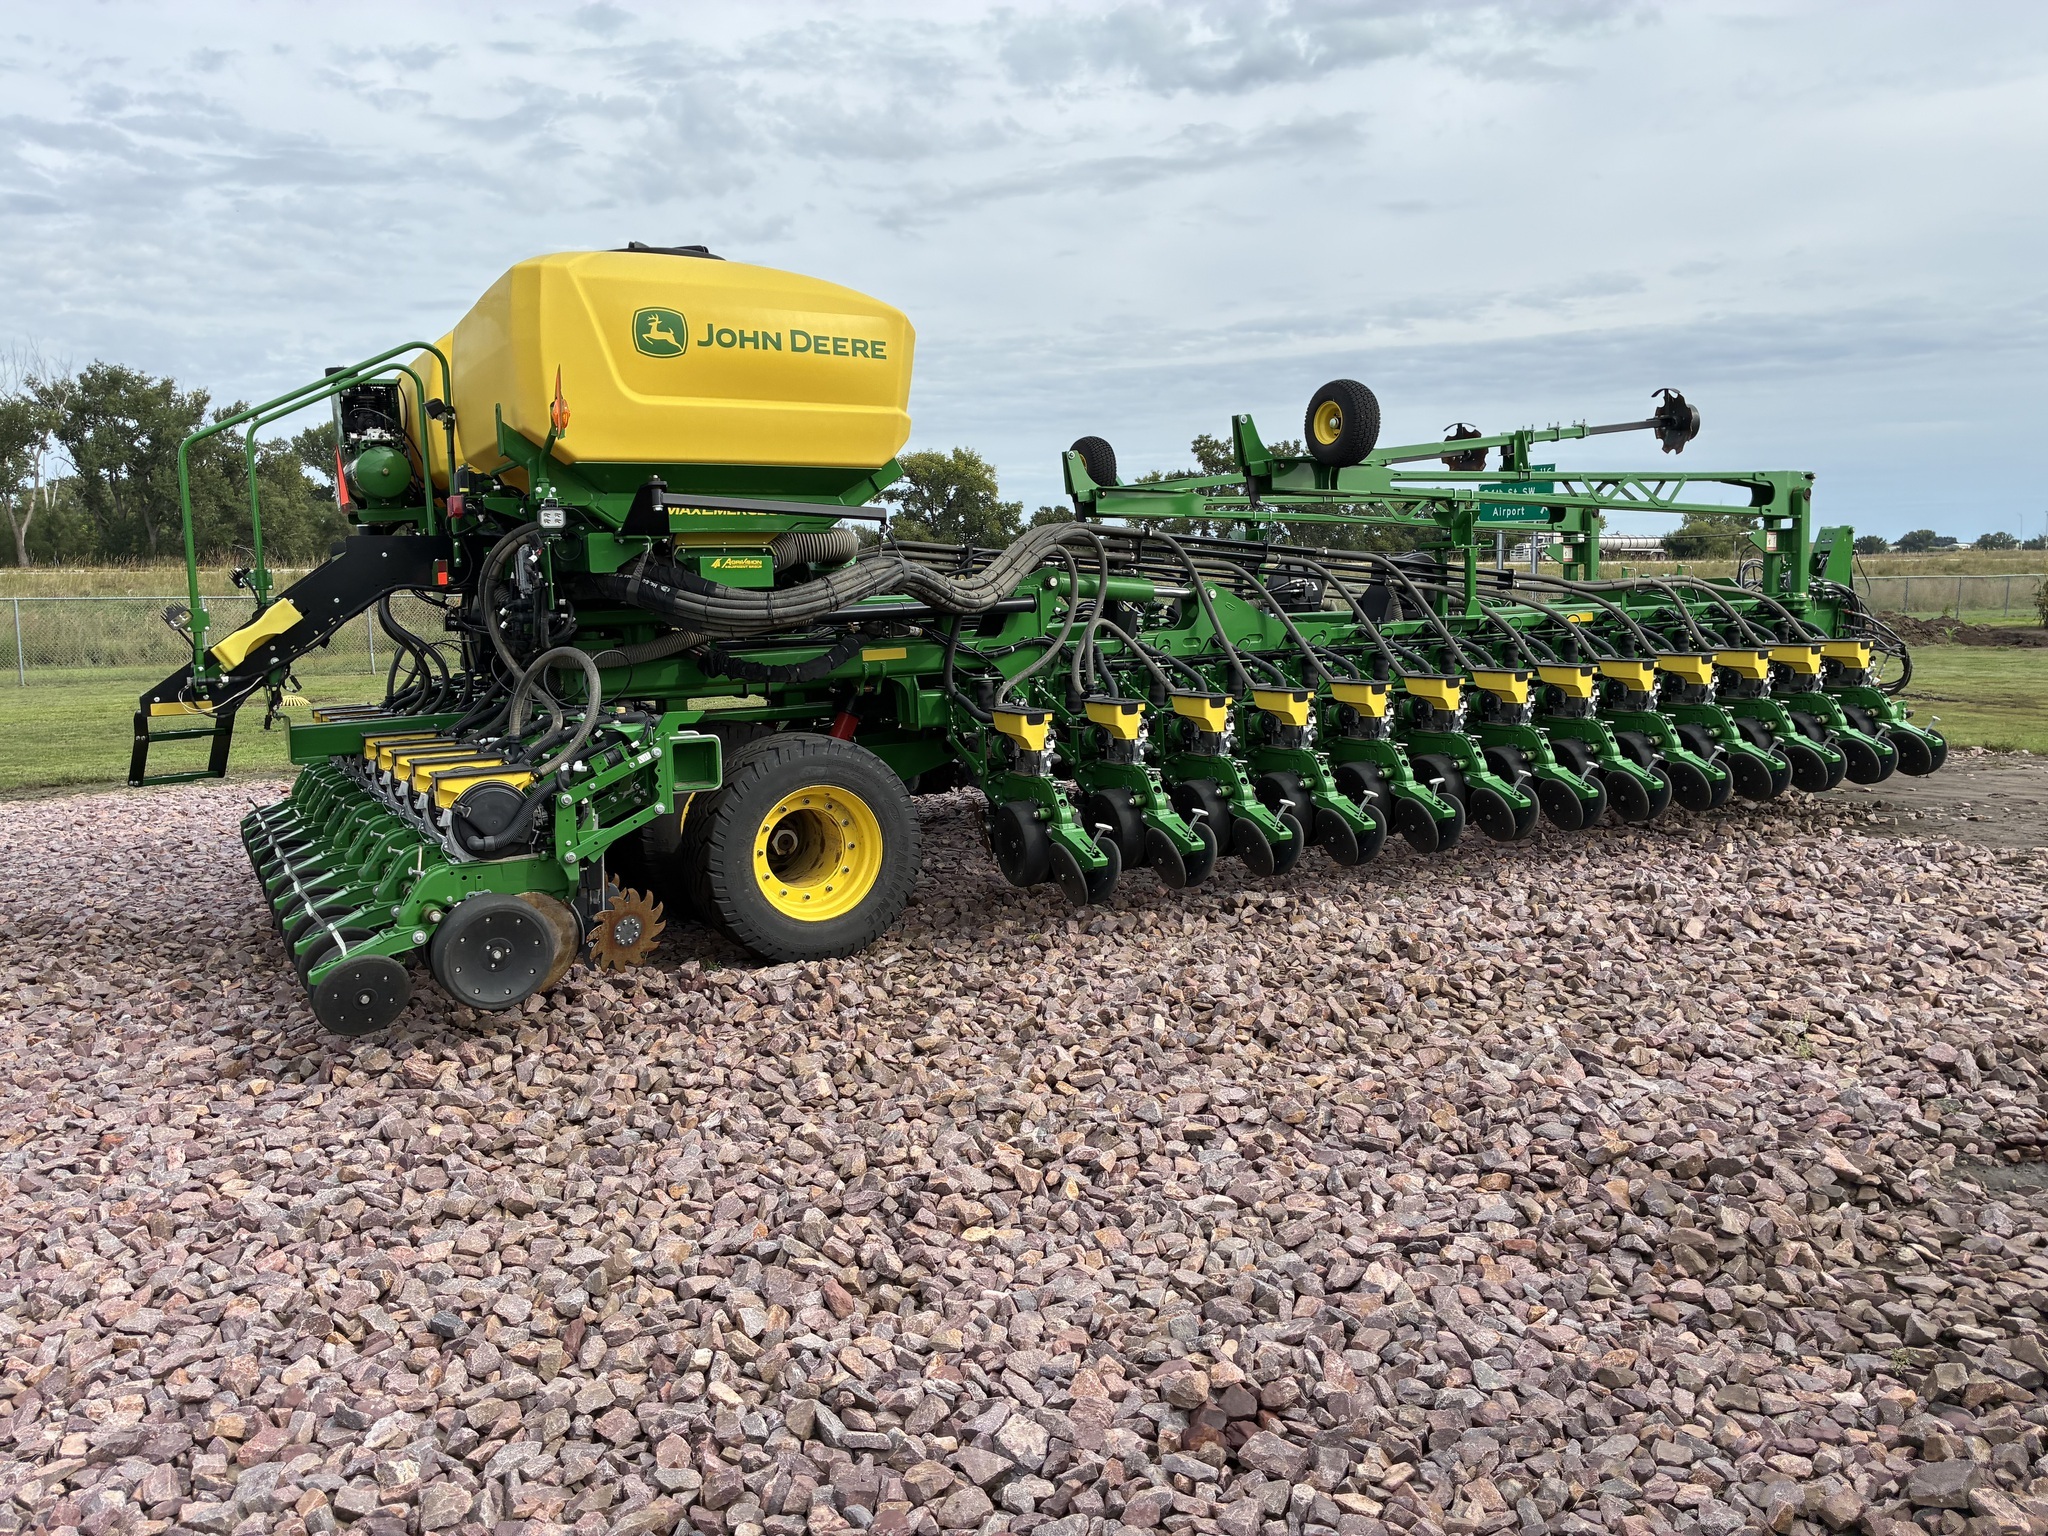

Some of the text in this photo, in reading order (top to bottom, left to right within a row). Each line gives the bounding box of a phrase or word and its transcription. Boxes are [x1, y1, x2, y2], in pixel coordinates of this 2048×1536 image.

[697, 323, 887, 360] JOHN DEERE
[1492, 506, 1525, 518] Airport
